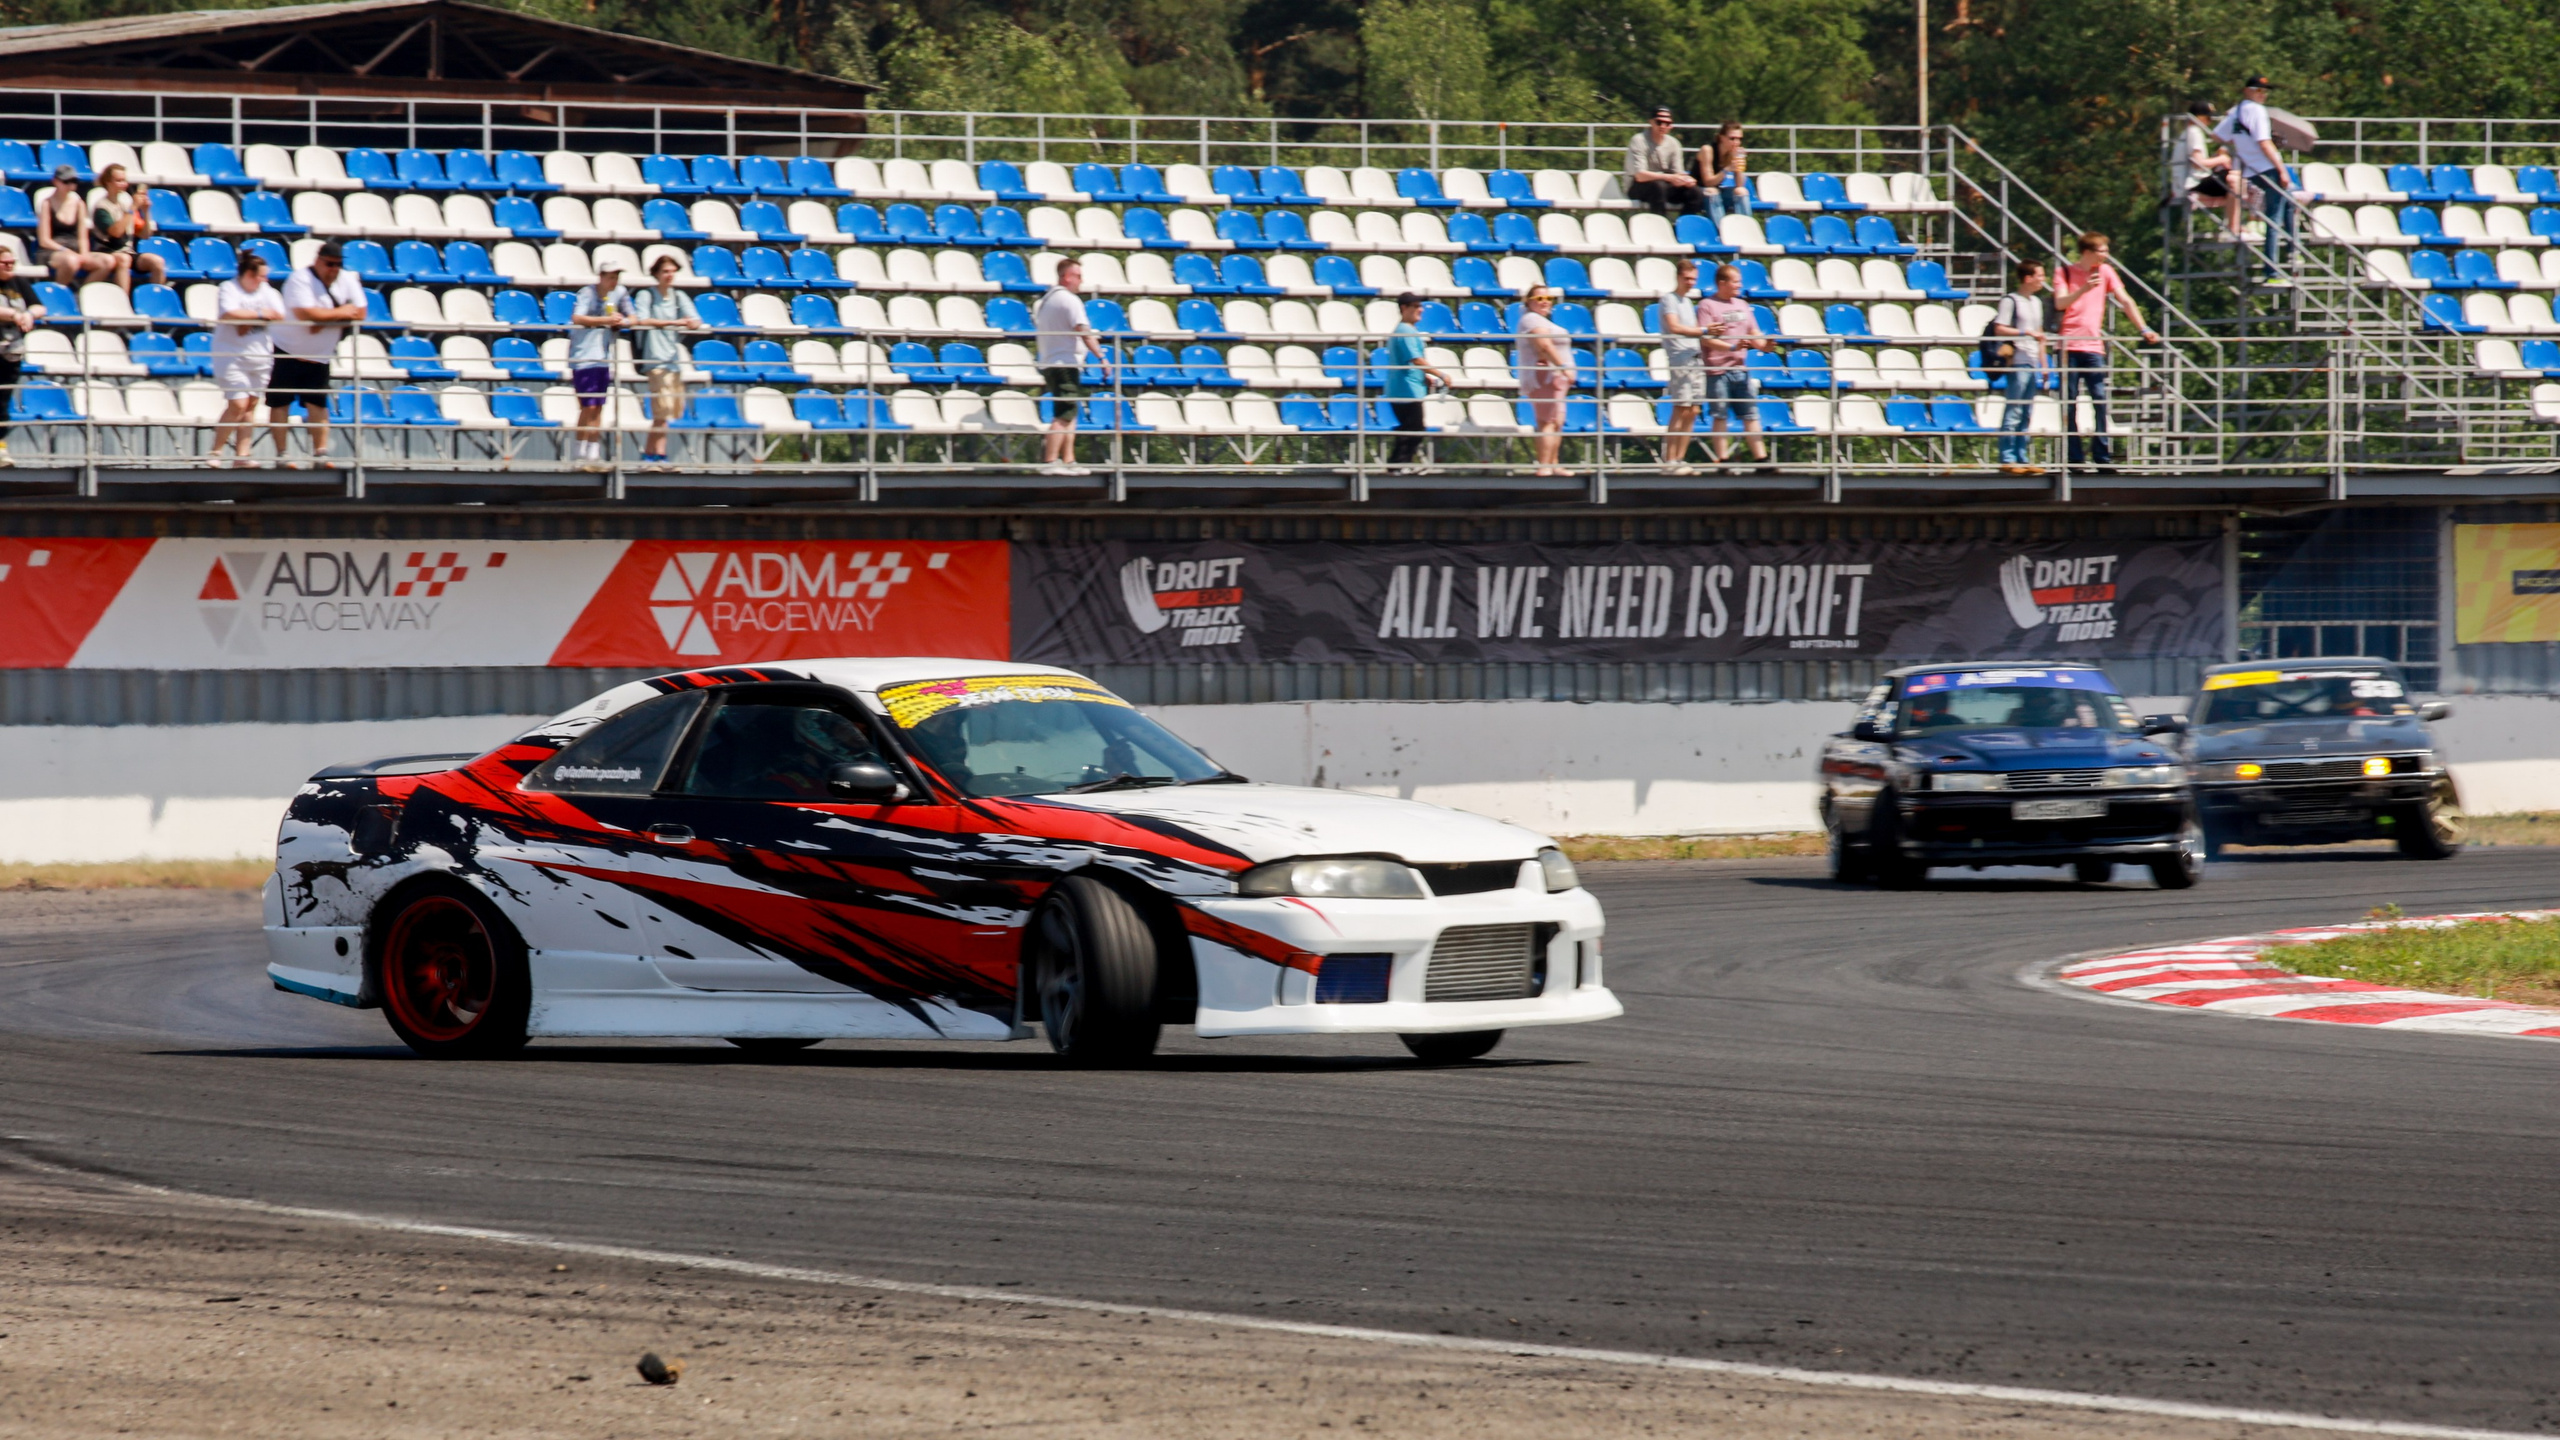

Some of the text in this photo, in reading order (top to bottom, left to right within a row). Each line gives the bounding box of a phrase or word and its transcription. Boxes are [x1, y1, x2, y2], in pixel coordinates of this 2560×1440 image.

[265, 551, 390, 597] ADM
[713, 551, 836, 598] ADM
[1155, 557, 1245, 591] DRIFT
[2033, 554, 2118, 588] DRIFT
[261, 601, 440, 631] RACEWAY
[711, 601, 883, 632] RACEWAY
[1377, 563, 1873, 638] ALL WE NEED IS DRIFT
